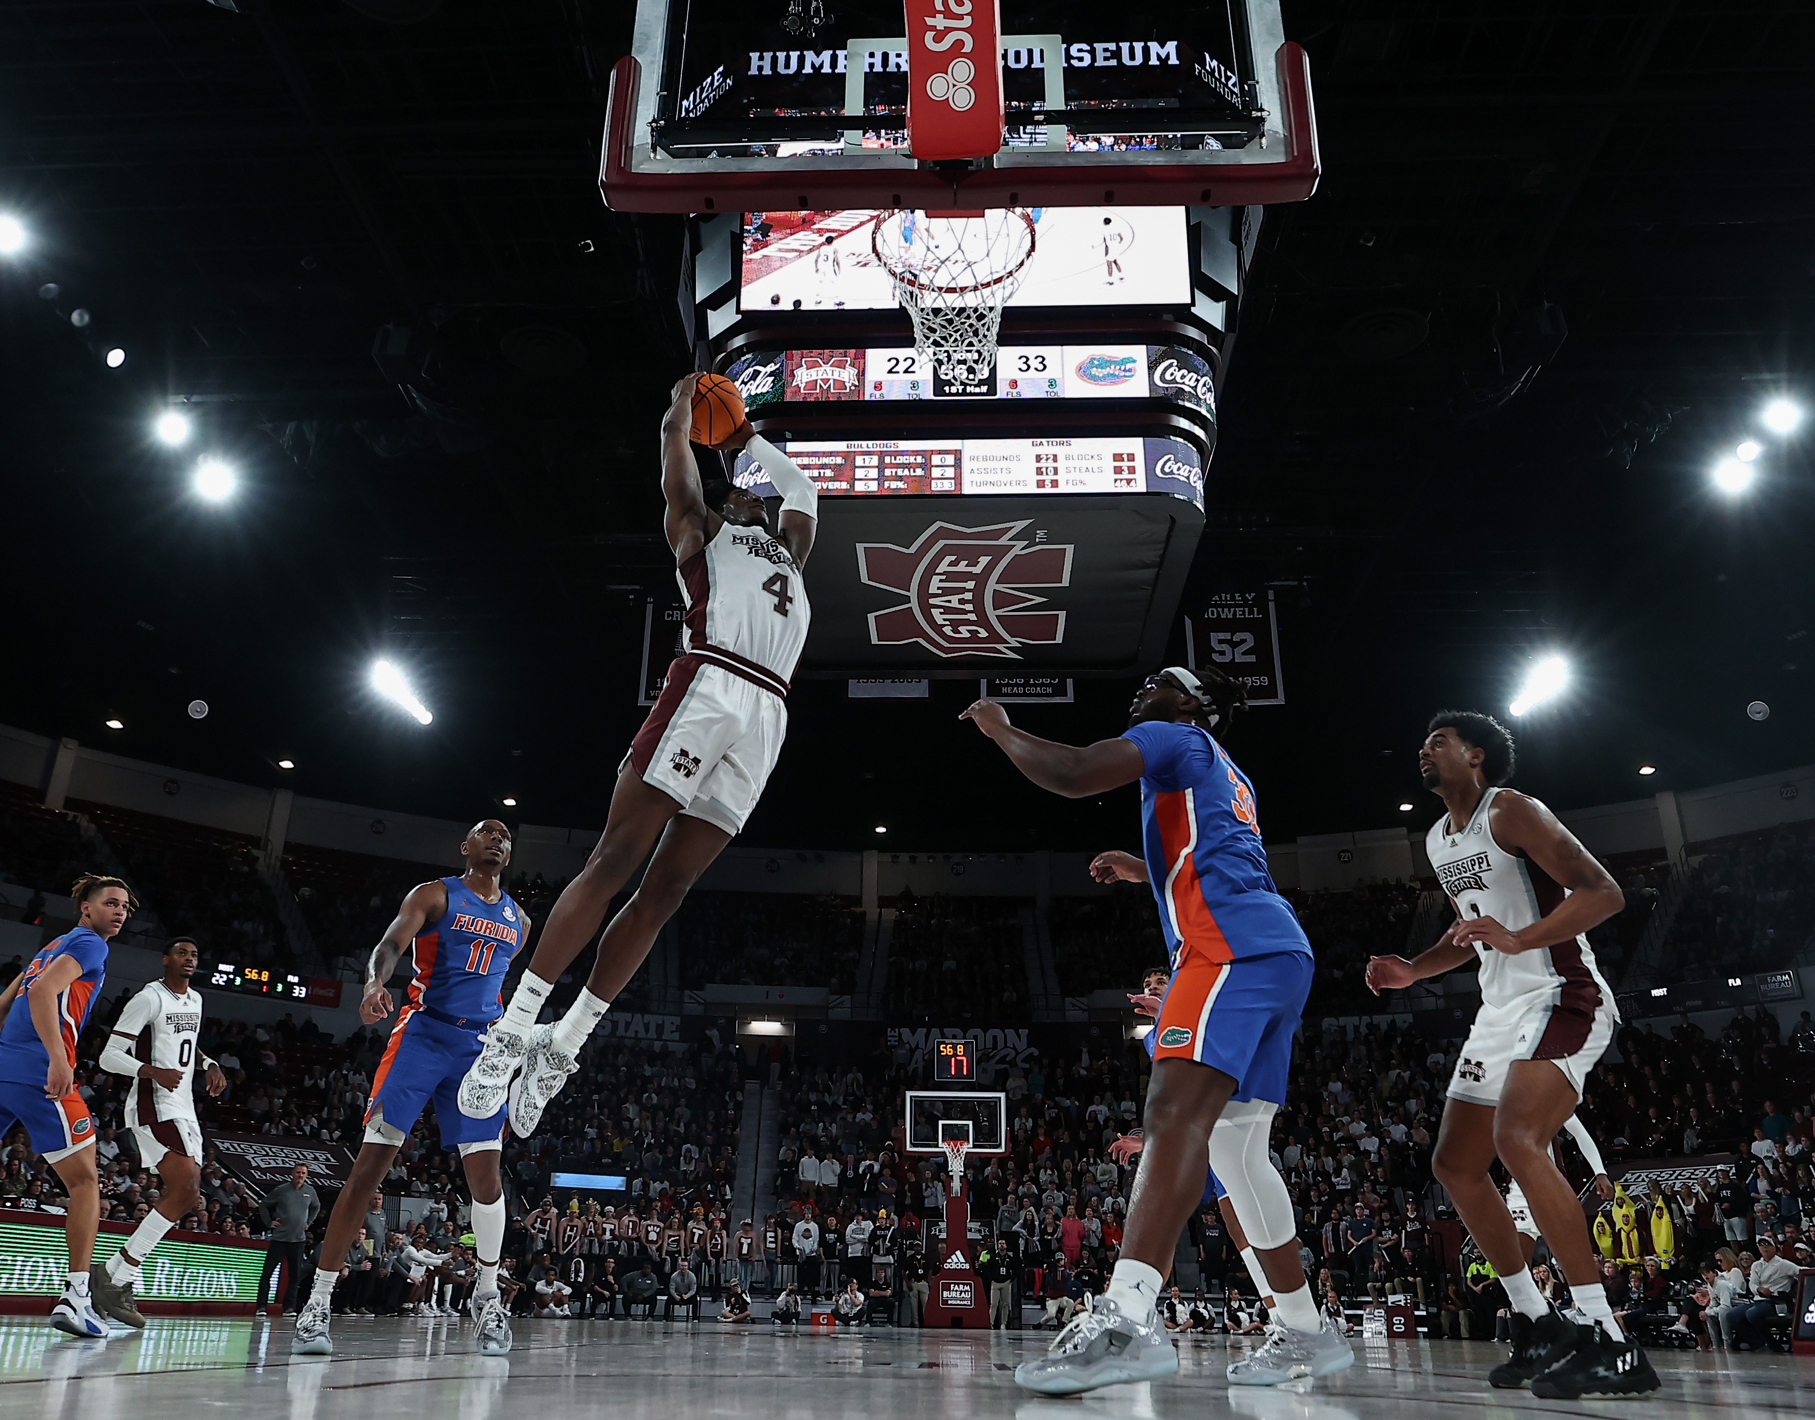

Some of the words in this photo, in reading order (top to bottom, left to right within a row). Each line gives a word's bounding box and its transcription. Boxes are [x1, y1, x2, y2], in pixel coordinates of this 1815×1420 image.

[1001, 41, 1180, 69] OLISEUM
[1204, 52, 1239, 93] MIZ
[681, 64, 725, 117] MIZE
[886, 357, 916, 375] 22
[1017, 355, 1047, 373] 33
[806, 368, 846, 380] STATE
[873, 381, 882, 391] 5
[910, 381, 919, 391] 3
[943, 385, 965, 393] 1ST
[966, 385, 989, 393] Half
[1009, 379, 1018, 390] 6
[1048, 379, 1057, 389] 3
[846, 442, 900, 450] BULLDOGS
[1031, 440, 1072, 448] GATORS
[861, 456, 873, 465] 17
[940, 456, 946, 464] 0
[1039, 454, 1054, 463] 22
[940, 469, 946, 477] 2
[1041, 467, 1054, 476] 10
[863, 482, 870, 490] 5
[932, 481, 953, 490] 33.3
[1035, 529, 1048, 543] TM
[762, 572, 793, 618] 4
[928, 555, 993, 638] STATE
[1205, 607, 1263, 619] OWELL
[1210, 632, 1256, 662] 52
[1002, 686, 1024, 694] HEAD
[1025, 686, 1053, 694] COACH
[678, 756, 697, 772] STATE
[1451, 878, 1480, 894] STATE
[450, 912, 518, 946] FLORIDA
[465, 938, 498, 975] 11
[245, 968, 269, 982] 56.8
[1767, 974, 1790, 983] FARM
[211, 973, 228, 985] 22
[234, 976, 242, 985] 3
[276, 983, 283, 992] 3
[292, 986, 307, 998] 33
[1760, 981, 1792, 991] BUREAU
[179, 1039, 192, 1067] 0
[940, 1044, 964, 1056] 56.8
[951, 1056, 969, 1076] 17
[214, 1139, 337, 1163] MISSISSIPPI
[944, 1262, 970, 1270] adidas
[820, 1314, 827, 1324] G
[1393, 1316, 1405, 1332] GO
